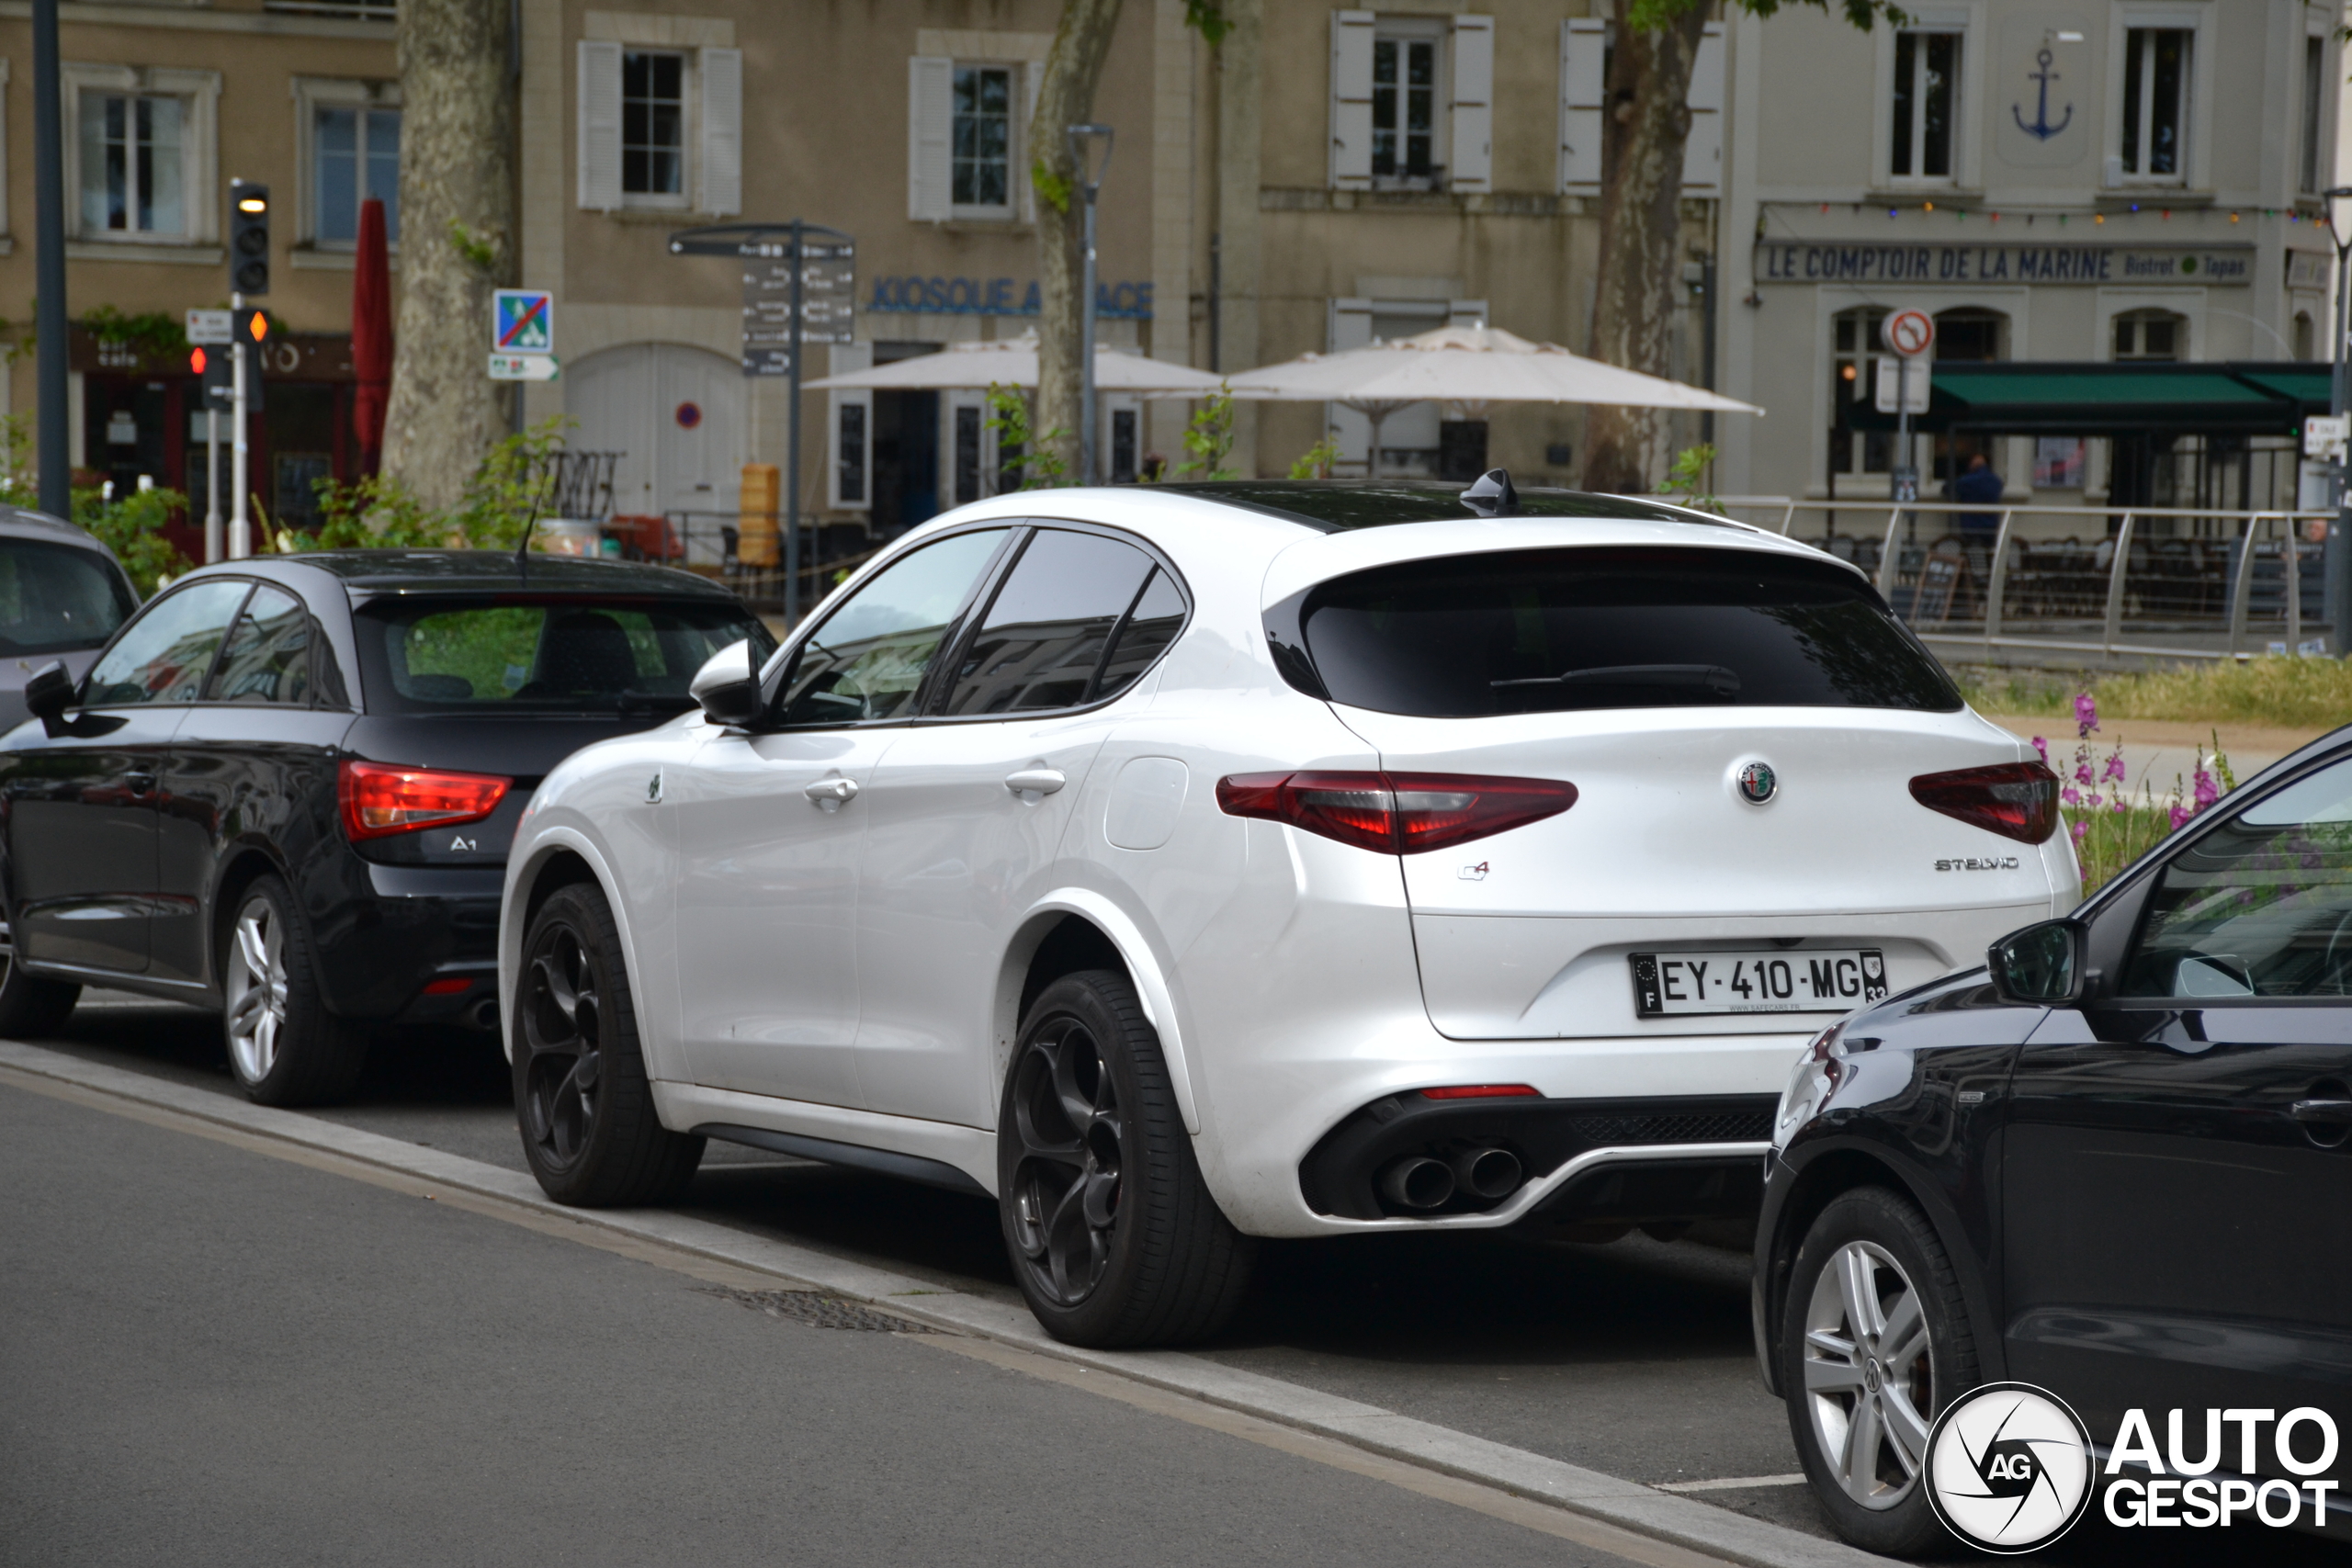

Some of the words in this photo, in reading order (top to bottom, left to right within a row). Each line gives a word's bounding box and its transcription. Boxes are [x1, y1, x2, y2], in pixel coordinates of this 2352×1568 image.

[1769, 246, 1796, 277] LE
[1805, 246, 1930, 278] COMPTOIR
[1939, 247, 1970, 279] DE
[1980, 248, 2008, 279] LA
[2018, 247, 2114, 280] MARINE
[2125, 254, 2175, 275] Bistrot
[2205, 255, 2245, 281] Tapas
[873, 276, 1015, 312] KIOSQUE
[450, 835, 477, 852] A1
[1457, 861, 1489, 882] Q4
[1933, 857, 2019, 872] STELVIO
[1645, 992, 1656, 1008] F
